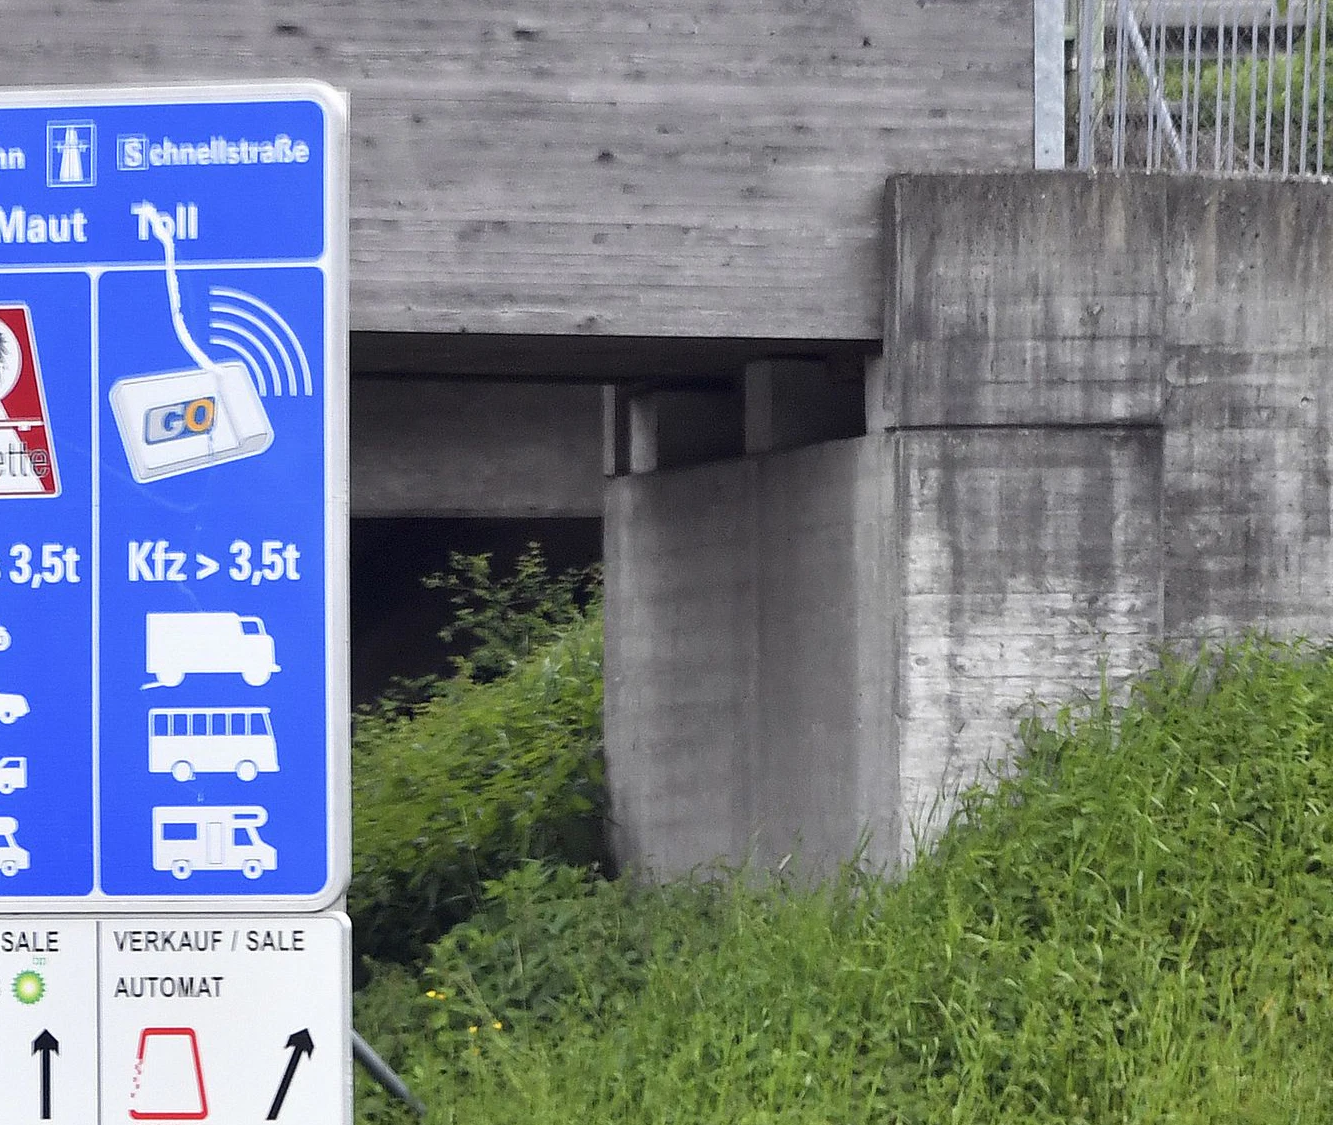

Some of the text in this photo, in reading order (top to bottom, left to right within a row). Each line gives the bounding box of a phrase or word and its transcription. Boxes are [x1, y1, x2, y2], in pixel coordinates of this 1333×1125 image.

[122, 133, 311, 168] Schnellstraße
[130, 200, 200, 242] Toll
[161, 395, 216, 437] GO
[8, 542, 81, 589] 3,5t
[127, 540, 187, 583] Kfz
[229, 539, 302, 586] 3,5t
[0, 931, 60, 953] SALE
[113, 930, 223, 951] VERKAUF
[245, 930, 306, 951] SALE
[113, 976, 225, 998] AUTOMAT
